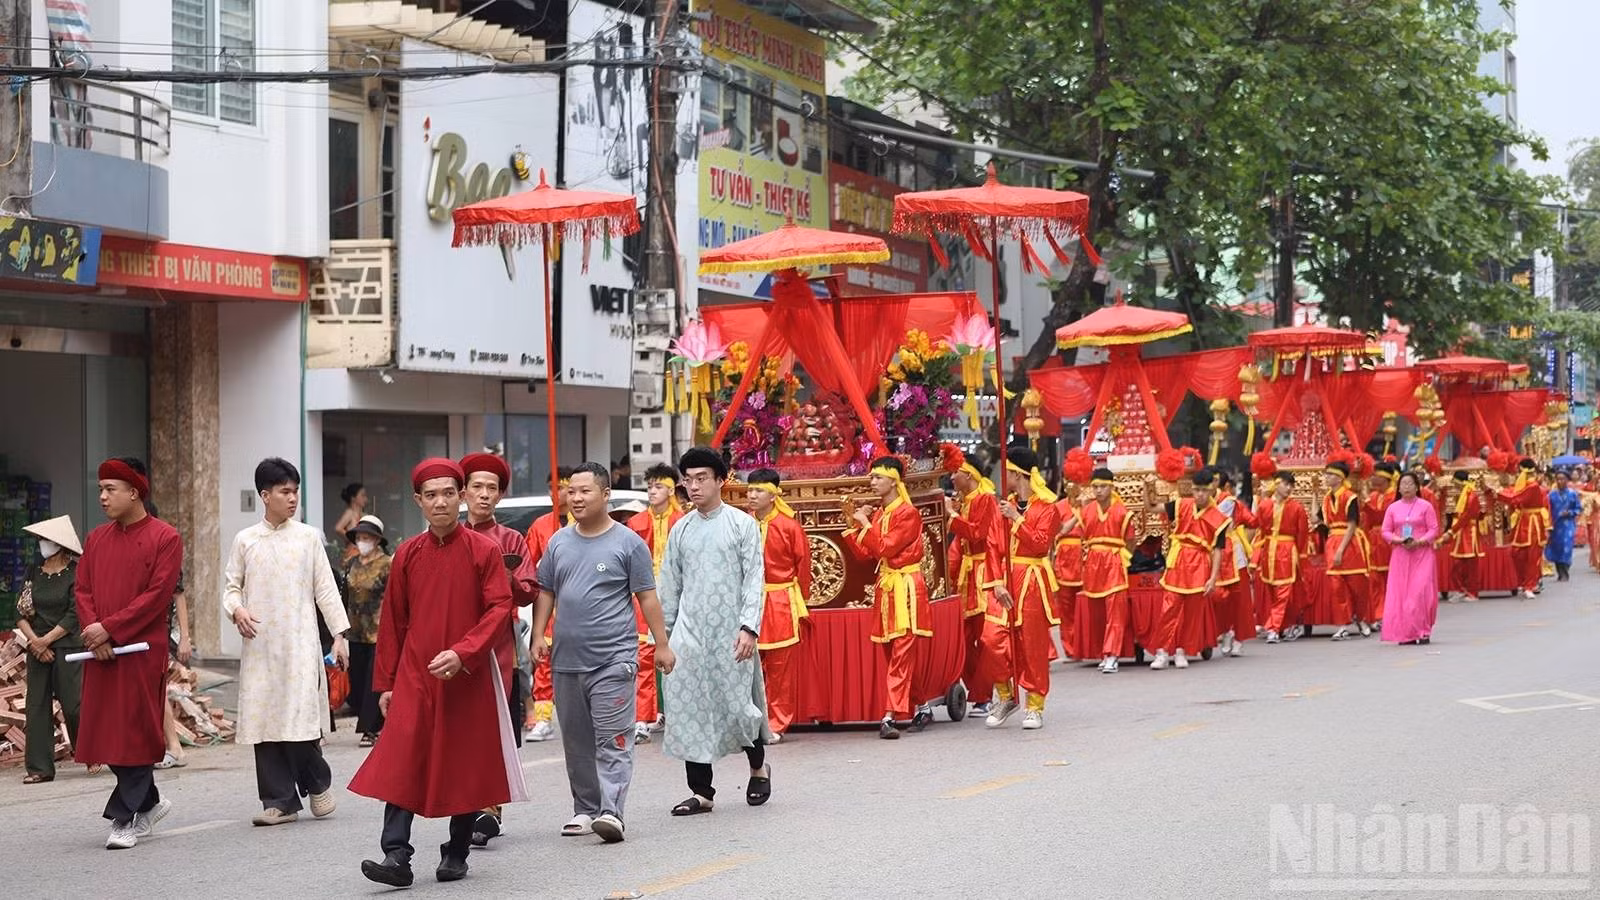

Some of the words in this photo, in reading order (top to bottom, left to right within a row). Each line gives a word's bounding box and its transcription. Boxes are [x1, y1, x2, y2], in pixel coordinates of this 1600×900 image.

[722, 13, 759, 61] THẤT
[762, 33, 795, 75] MINH
[797, 46, 825, 84] ANH
[709, 166, 726, 203] TƯ
[728, 158, 753, 209] VẤN
[763, 170, 795, 216] THIẾT
[795, 176, 812, 223] KẾ
[119, 246, 161, 278] THIẾT
[165, 256, 179, 284] BỊ
[182, 255, 212, 284] VĂN
[215, 259, 263, 289] PHÒNG
